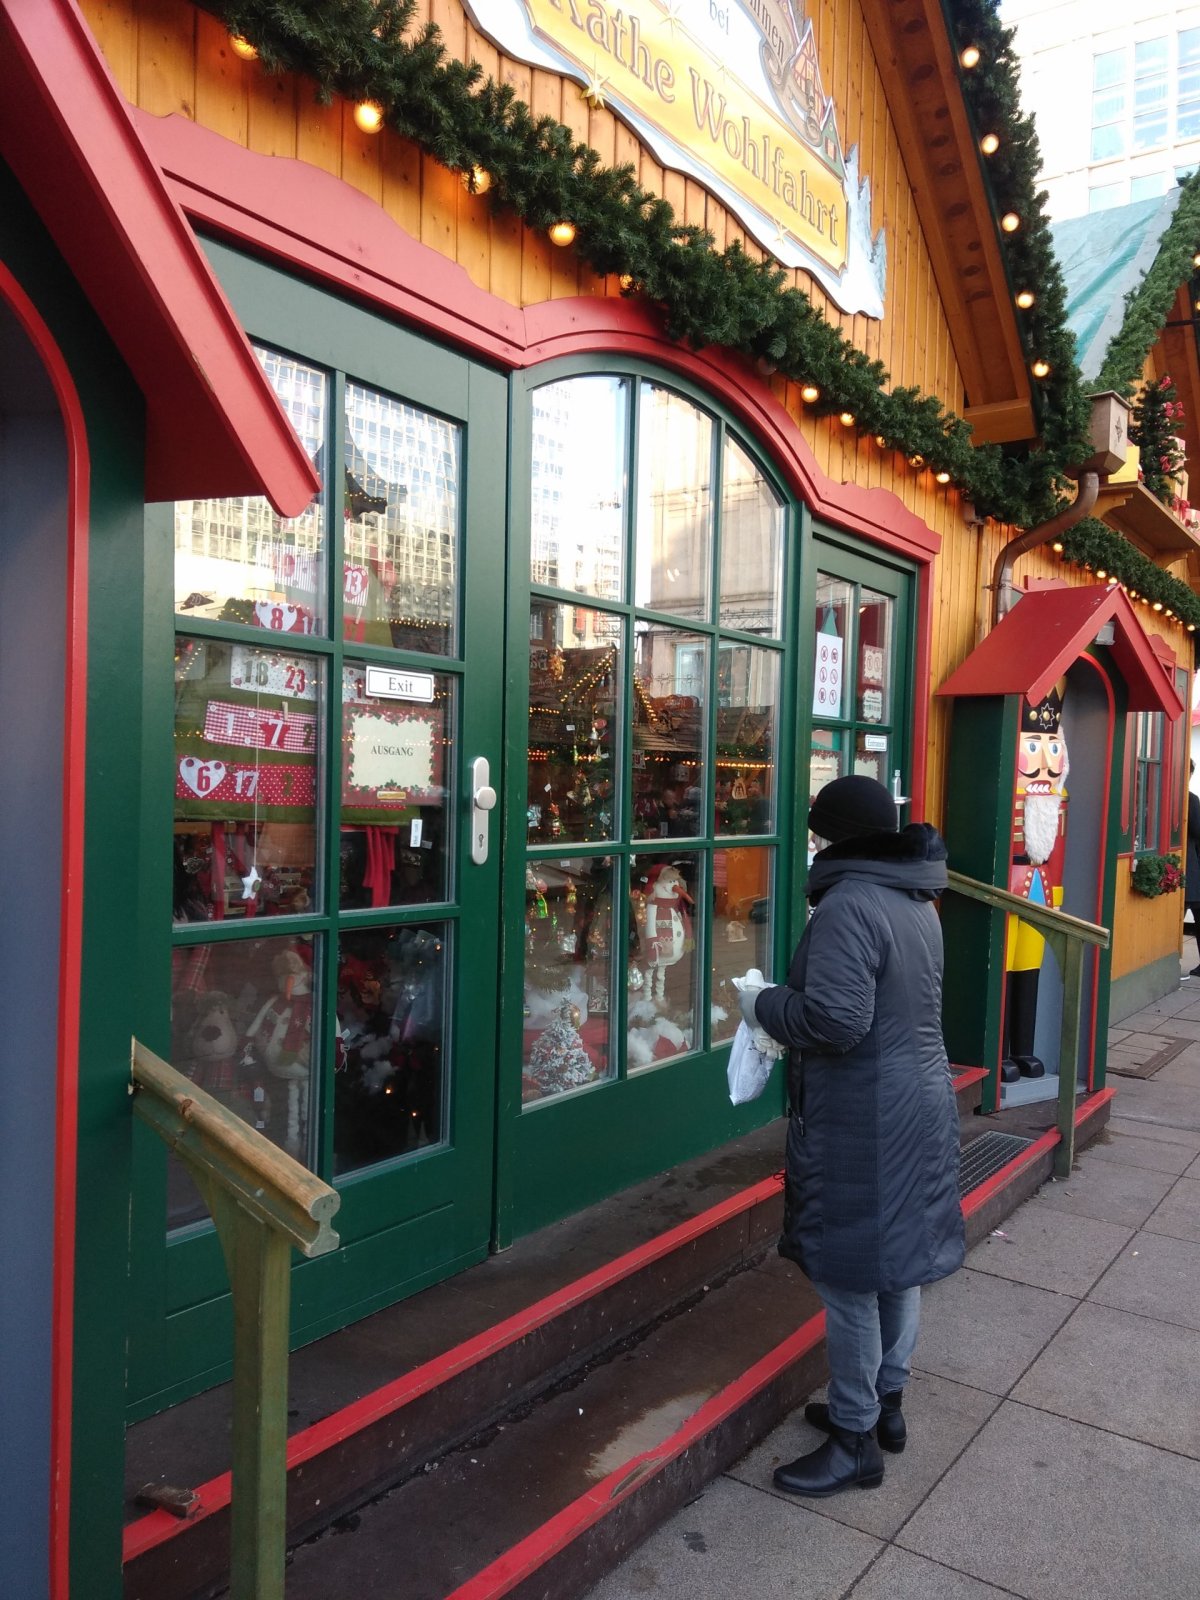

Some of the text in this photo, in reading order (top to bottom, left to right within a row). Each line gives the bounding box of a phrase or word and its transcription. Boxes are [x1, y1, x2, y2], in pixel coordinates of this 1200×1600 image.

[688, 66, 839, 247] Wohlfahrt
[344, 569, 363, 596] 13
[270, 607, 284, 630] 8
[244, 660, 306, 693] 18 23
[388, 677, 414, 693] Exit
[268, 719, 284, 746] 7
[371, 746, 414, 757] AUSGANG
[197, 766, 211, 792] 6
[234, 771, 260, 797] 17
